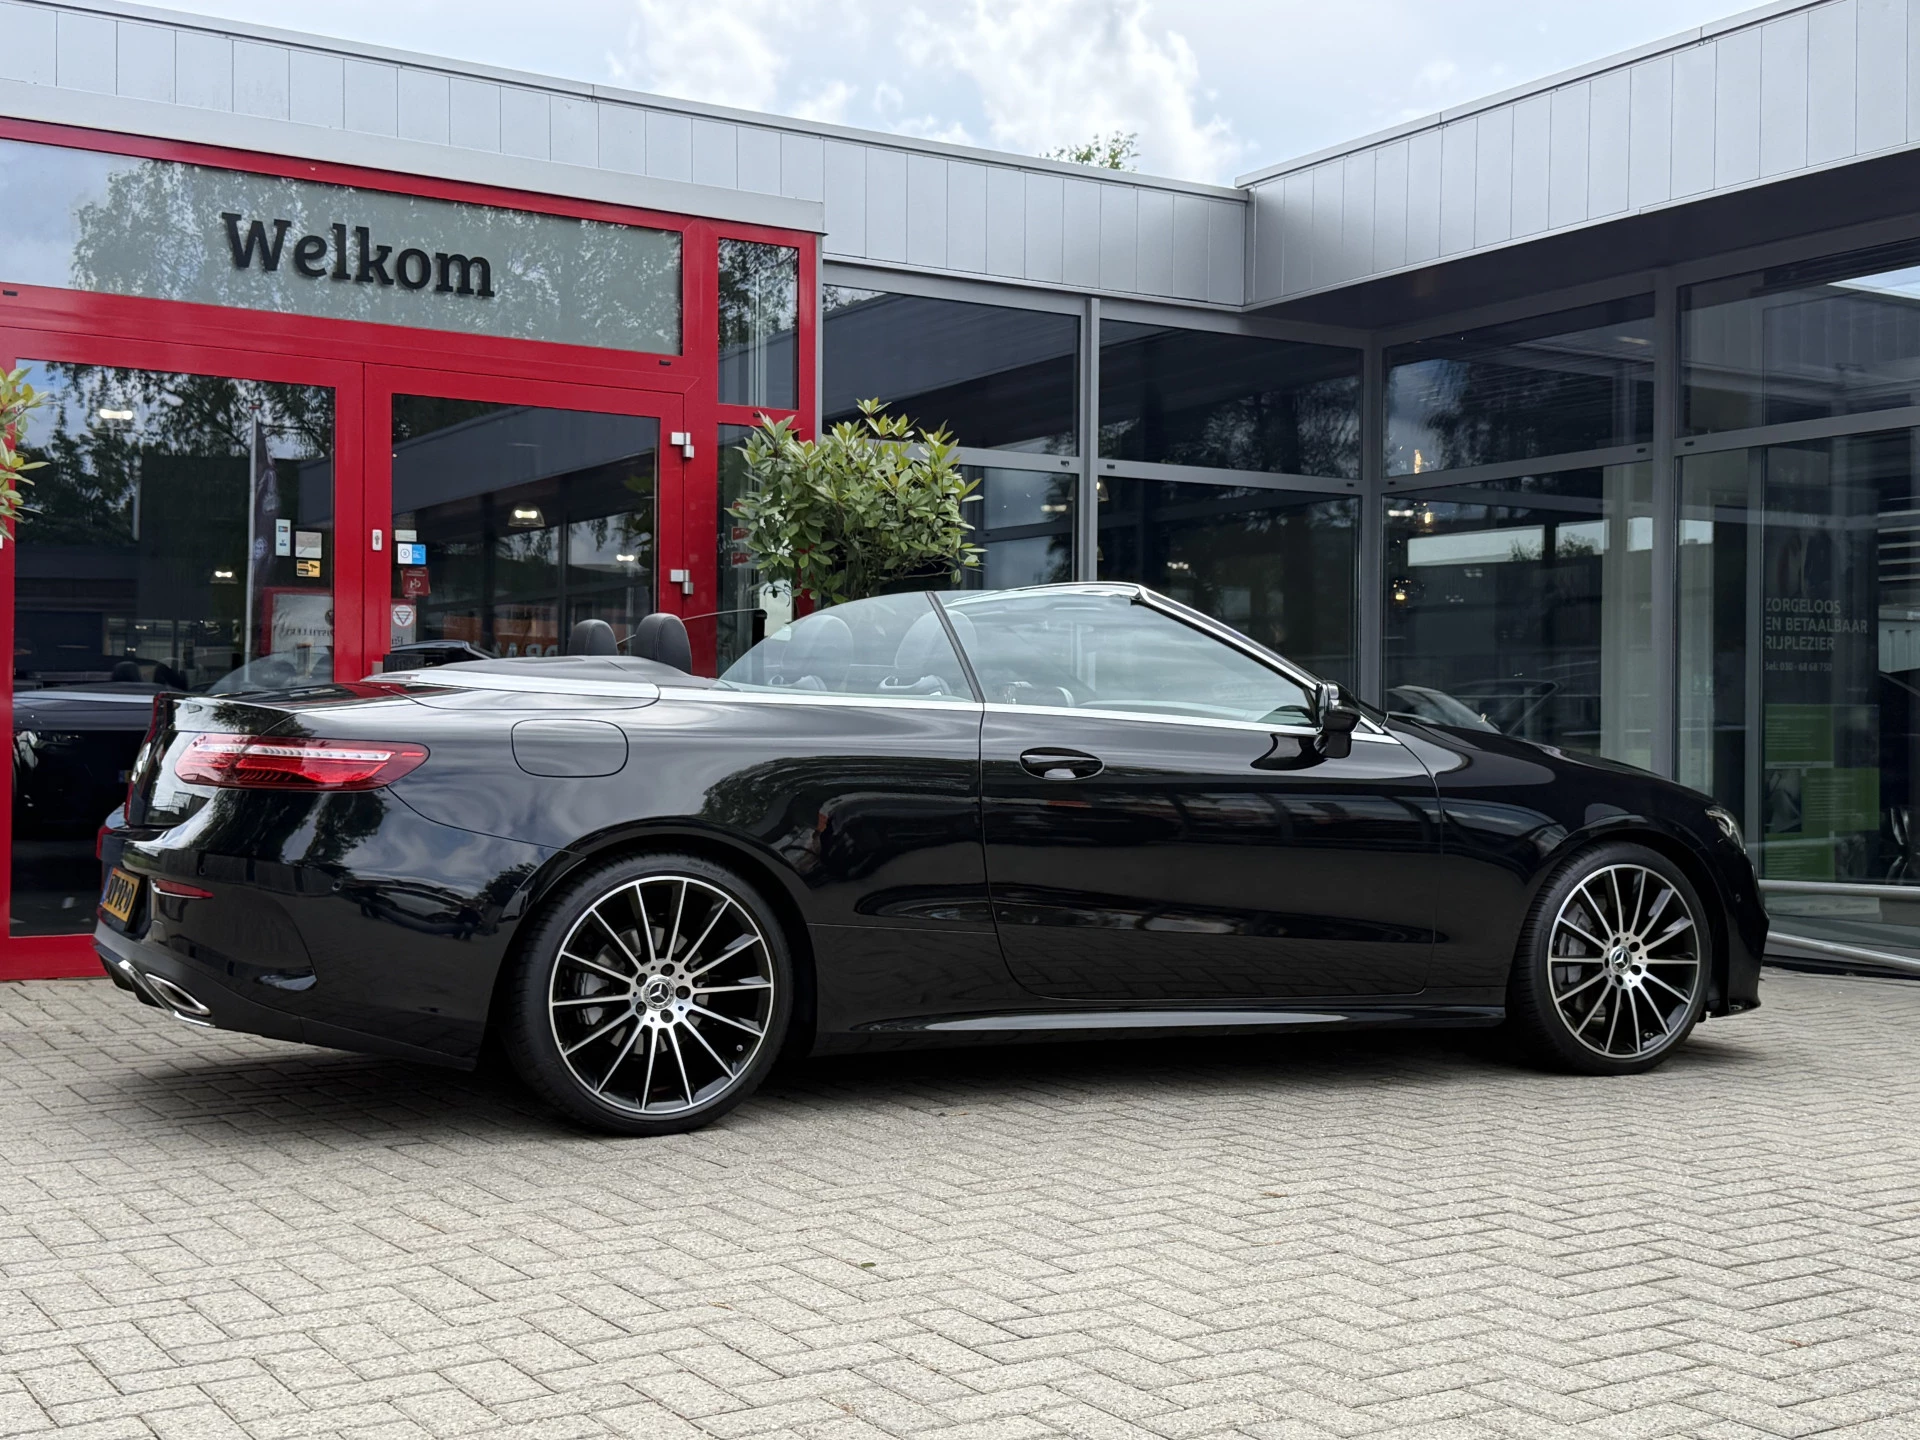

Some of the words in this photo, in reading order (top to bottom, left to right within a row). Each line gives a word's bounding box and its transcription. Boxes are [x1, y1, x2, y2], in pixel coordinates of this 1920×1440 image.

[221, 211, 495, 298] Welkom
[1765, 597, 1841, 614] ZORGELOOS
[1765, 616, 1782, 631] EN
[1785, 617, 1868, 634] BETAALBAAR
[1765, 635, 1836, 650] RIJPLEZIER
